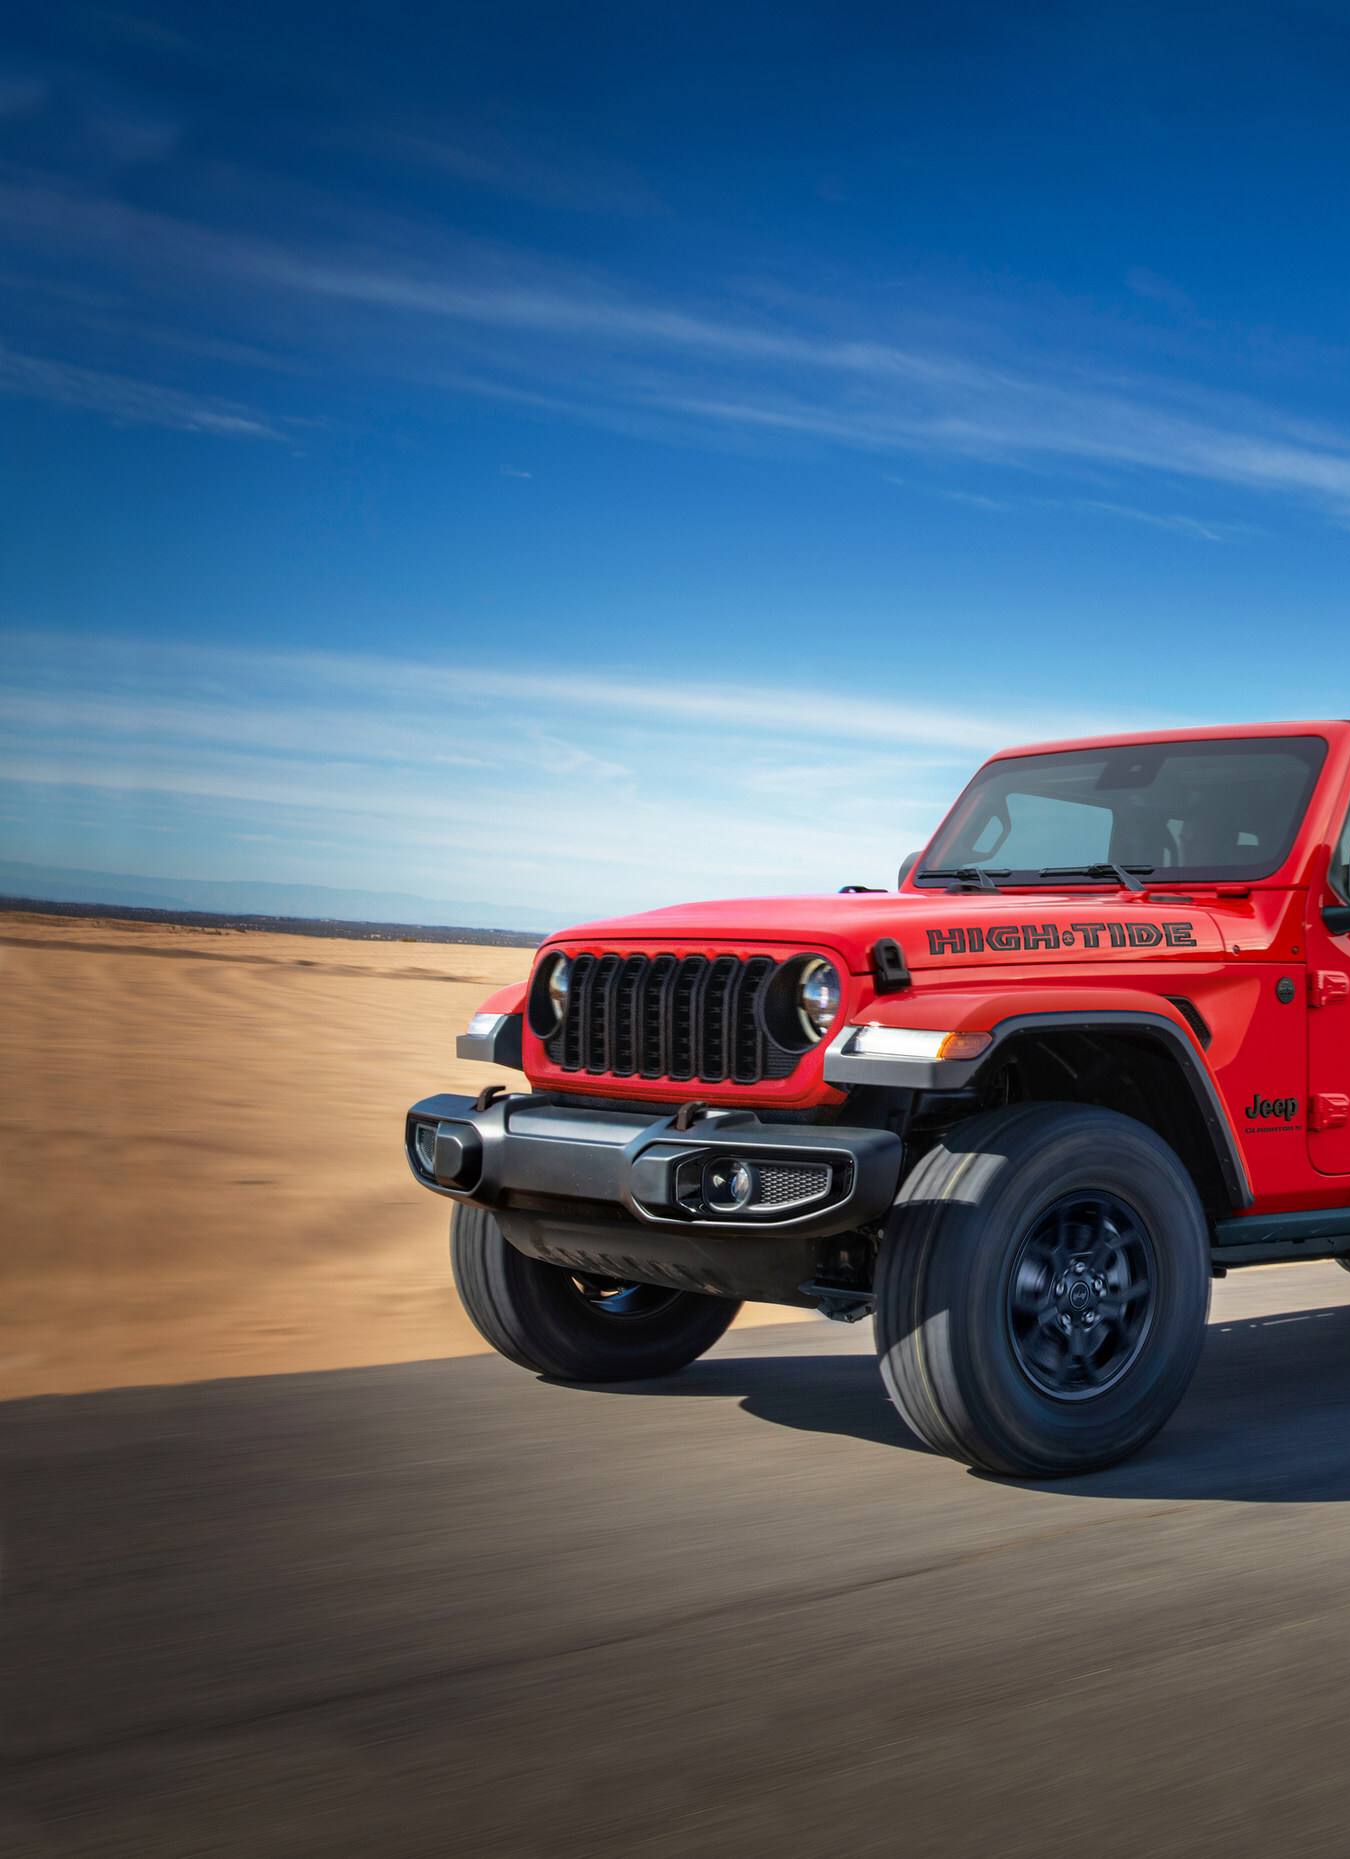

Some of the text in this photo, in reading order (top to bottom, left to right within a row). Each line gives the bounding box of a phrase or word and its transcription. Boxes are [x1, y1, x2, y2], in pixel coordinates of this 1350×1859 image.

[925, 922, 1197, 955] HIGH TIDE
[1245, 1093, 1299, 1122] Jeep
[1244, 1126, 1294, 1134] GLADIATOR
